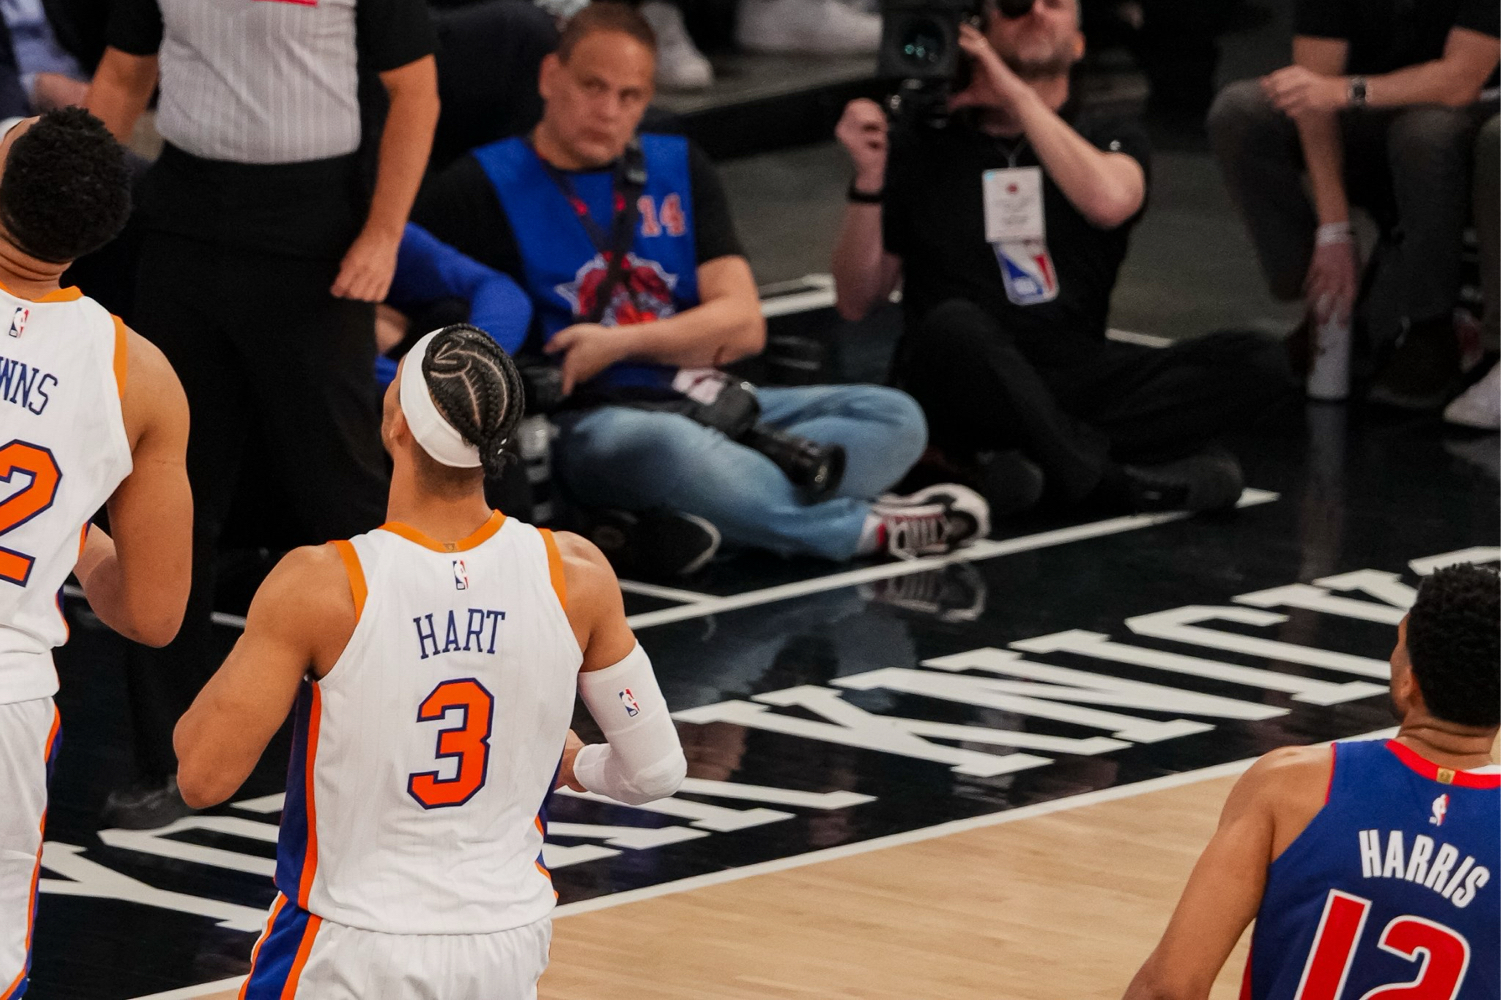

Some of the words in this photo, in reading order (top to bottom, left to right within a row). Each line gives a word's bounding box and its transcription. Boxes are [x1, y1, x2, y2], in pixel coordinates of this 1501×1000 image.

[637, 192, 686, 238] 14
[413, 607, 506, 660] HART
[407, 677, 495, 810] 3
[1358, 829, 1491, 909] HARRIS
